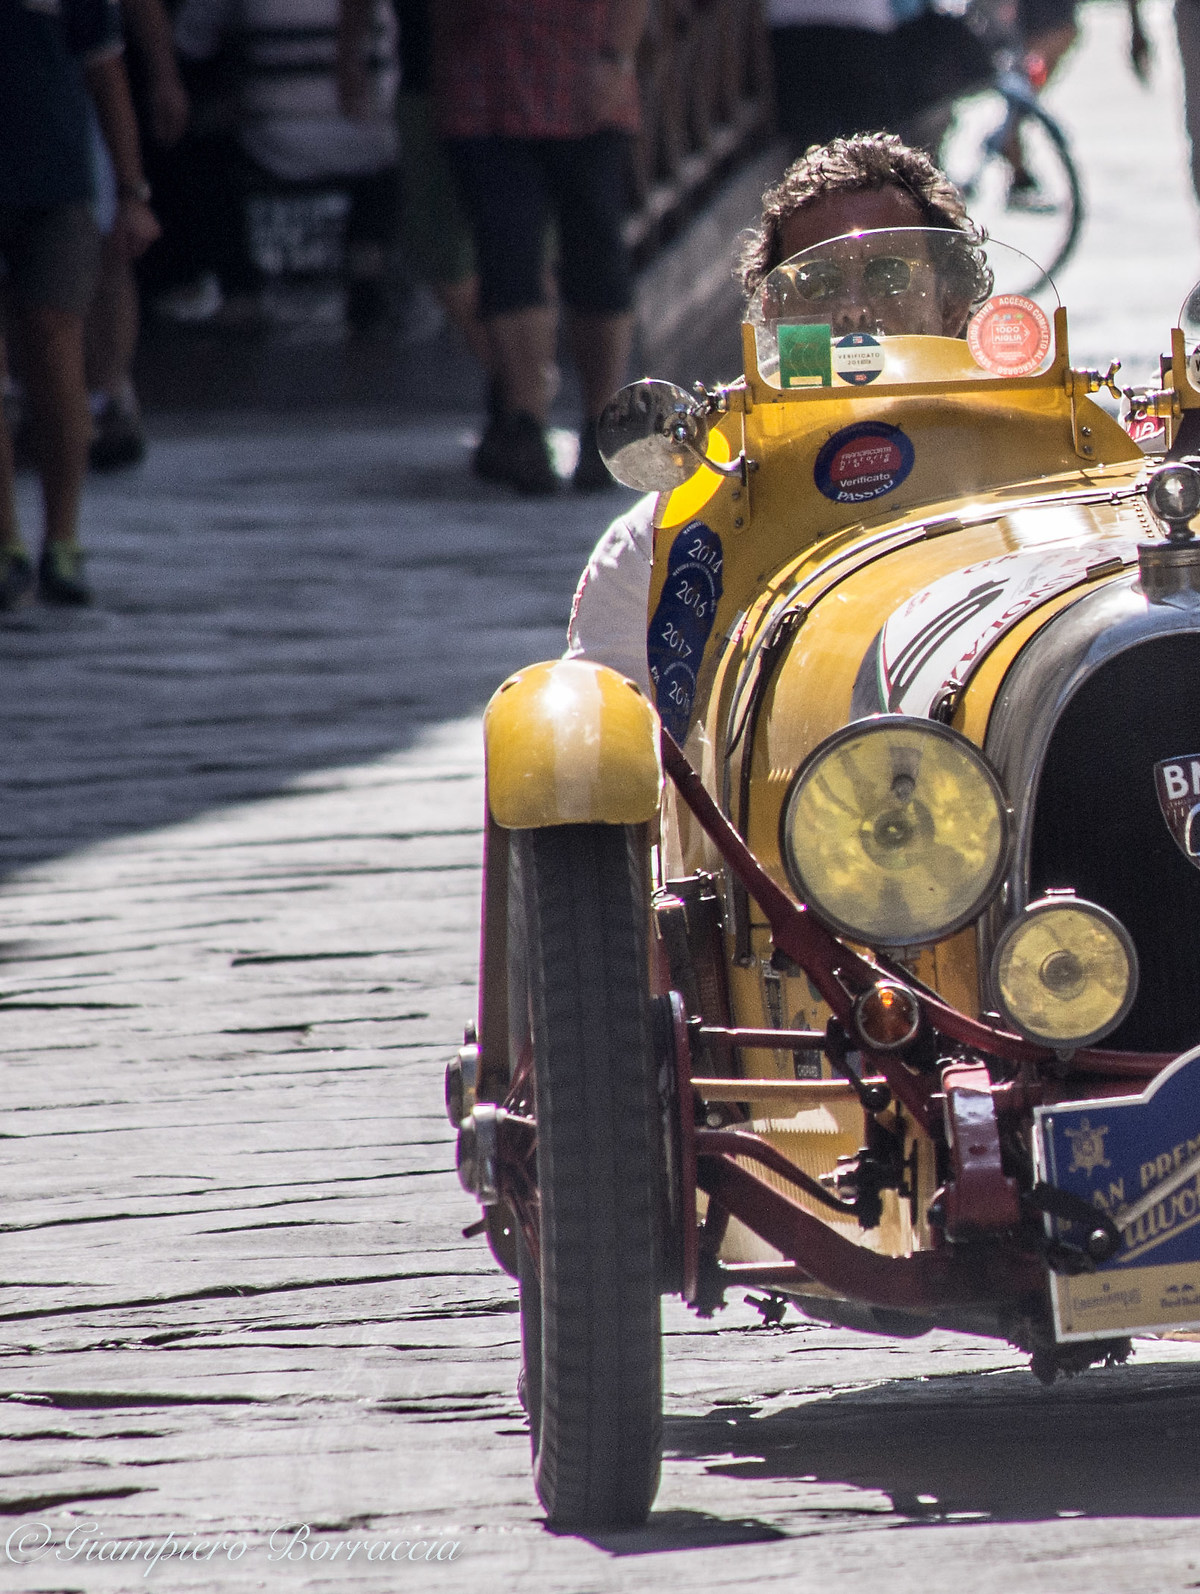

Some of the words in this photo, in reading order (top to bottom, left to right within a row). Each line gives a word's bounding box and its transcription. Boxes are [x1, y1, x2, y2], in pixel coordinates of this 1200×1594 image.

[999, 296, 1034, 311] ACCESSO
[1032, 308, 1050, 349] COMPLETO
[838, 352, 880, 360] VERIFICATO
[997, 358, 1038, 375] PERCORSO
[836, 479, 894, 502] PASSED
[840, 473, 891, 488] Verificato
[688, 538, 724, 574] 2014
[675, 580, 708, 618] 2016
[661, 622, 692, 659] 2017
